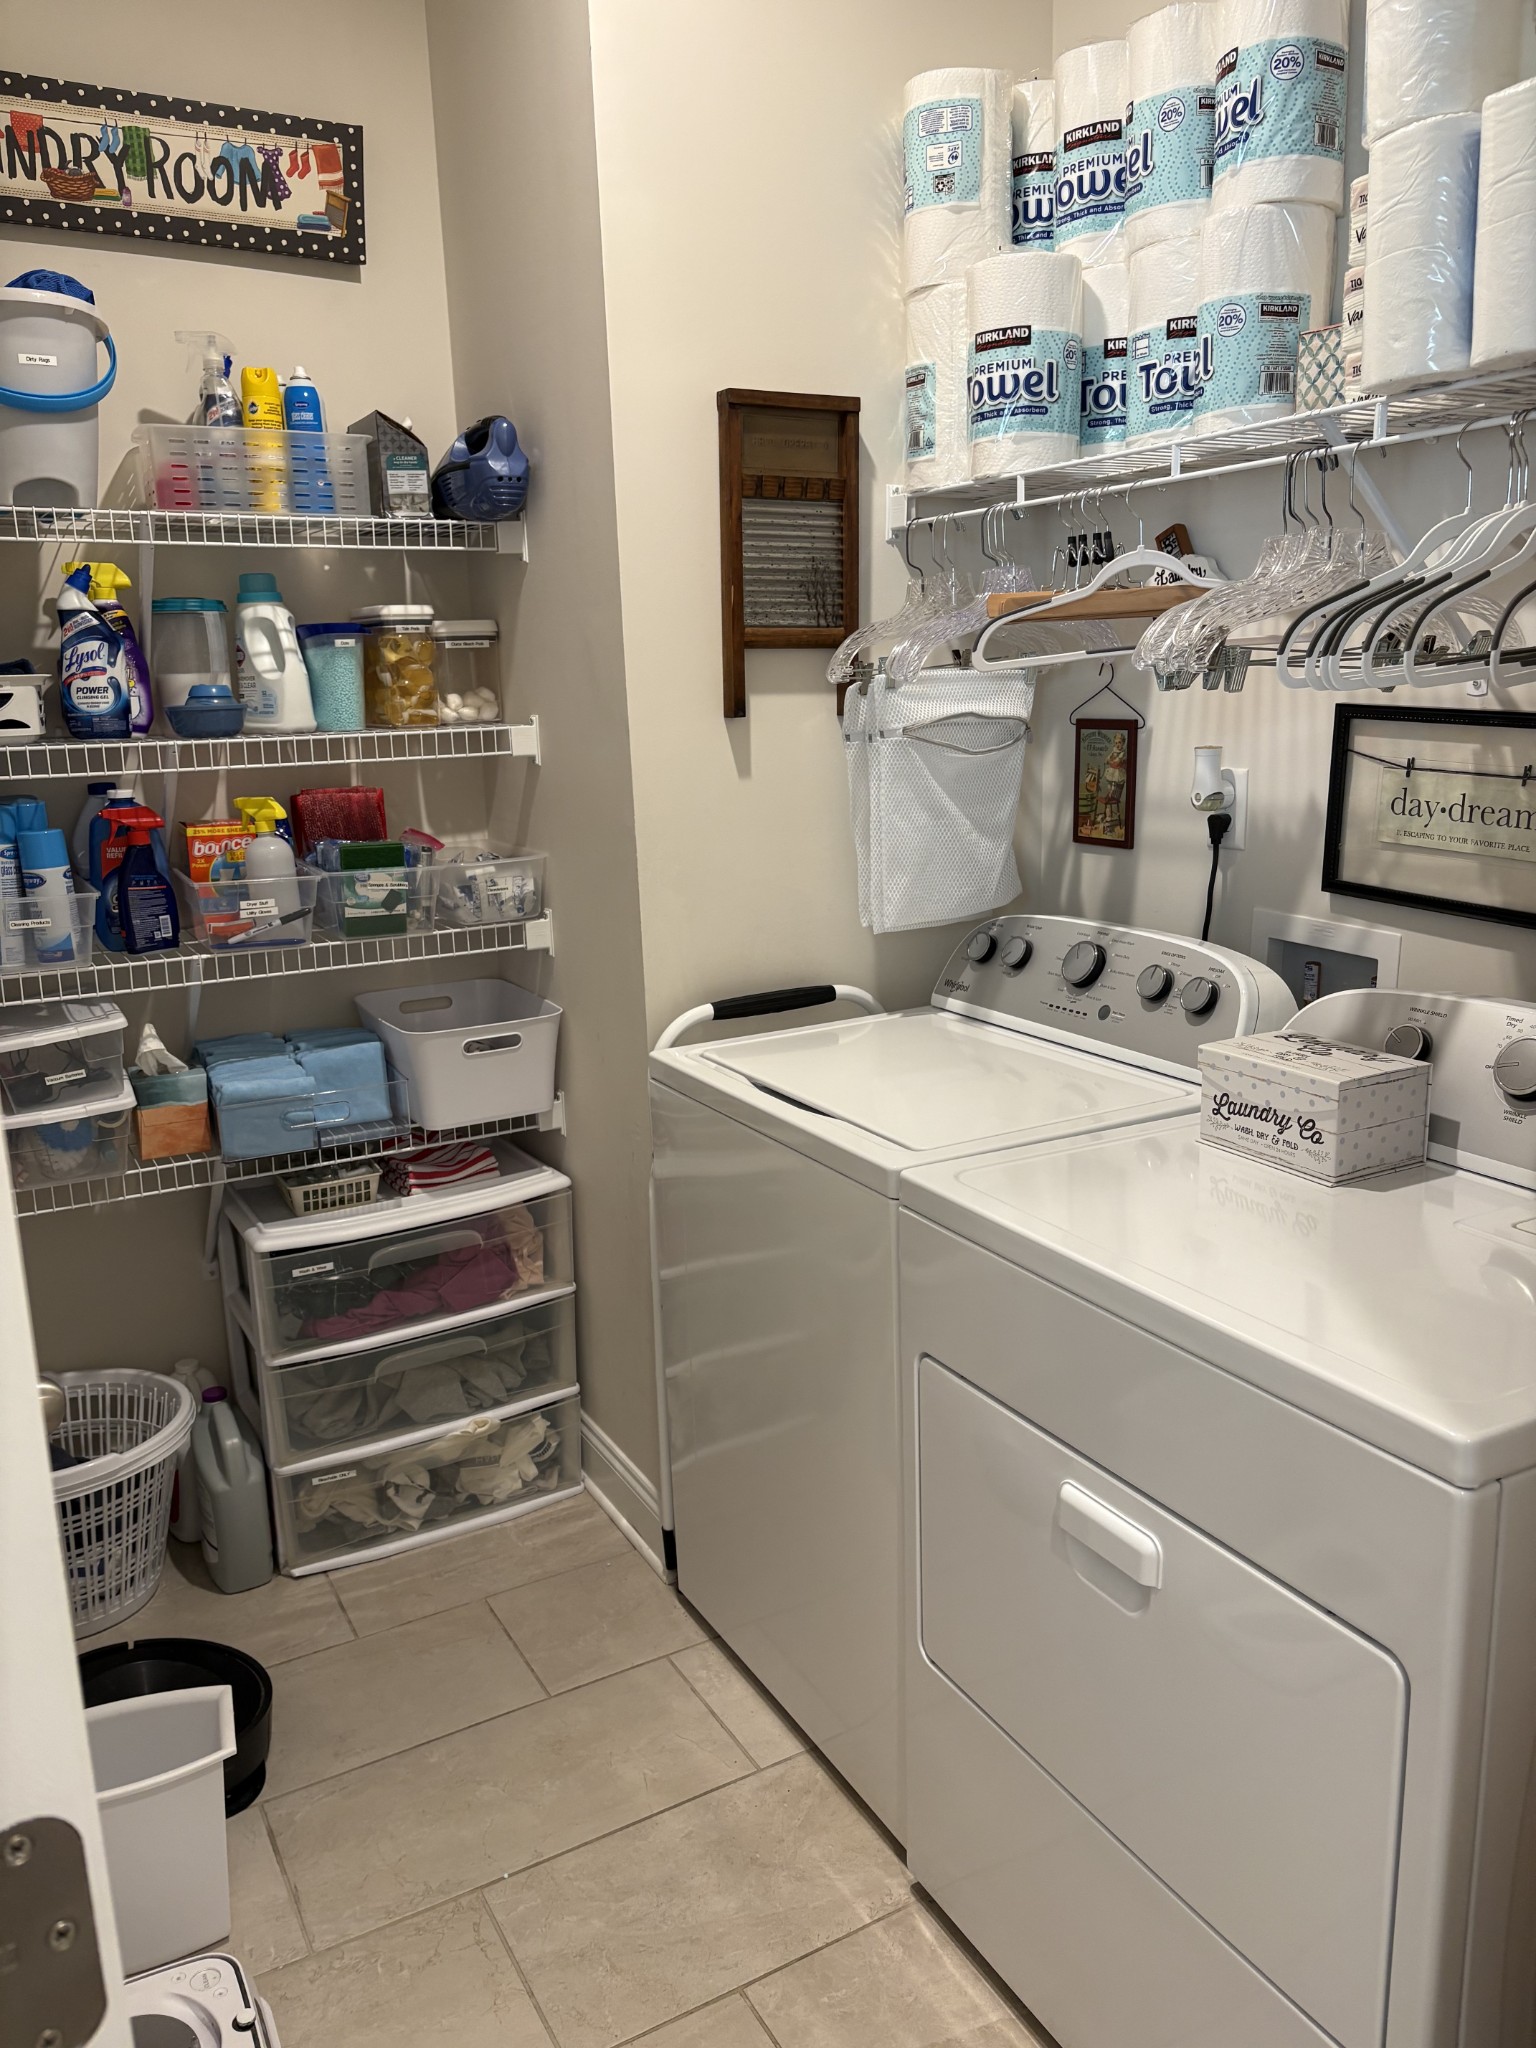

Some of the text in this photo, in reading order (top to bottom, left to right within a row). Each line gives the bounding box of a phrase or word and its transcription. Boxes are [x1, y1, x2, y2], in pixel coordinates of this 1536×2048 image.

[1273, 56, 1301, 70] 20%
[1161, 106, 1182, 122] 20%
[1066, 122, 1119, 143] KIRKLAND
[1063, 154, 1122, 177] PREMIUM
[149, 136, 282, 211] ROOM
[1073, 210, 1088, 218] Thick
[1263, 305, 1298, 313] KIRKLAND
[1219, 313, 1244, 328] 20%
[976, 328, 1029, 345] KIRKLAND
[974, 358, 1032, 375] PREMIUM
[1089, 417, 1113, 427] Strong,
[64, 642, 107, 672] Lysol
[76, 686, 109, 694] POWER
[194, 836, 252, 857] bounce
[1403, 830, 1435, 841] ESCAPING
[1449, 836, 1469, 845] YOUR
[1471, 839, 1506, 850] FAVORITE
[1508, 843, 1530, 853] PLACE
[945, 979, 970, 993] Whirlpool
[1409, 1006, 1448, 1019] WRINKLE SHIELD
[1506, 1015, 1524, 1024] Timed
[1506, 1021, 1518, 1029] Dry
[1212, 1093, 1324, 1145] Laundry Co
[1502, 1115, 1523, 1125] SHIELD
[1503, 1109, 1527, 1120] WRINKLE
[1234, 1124, 1299, 1151] WASH DRY & FOLD
